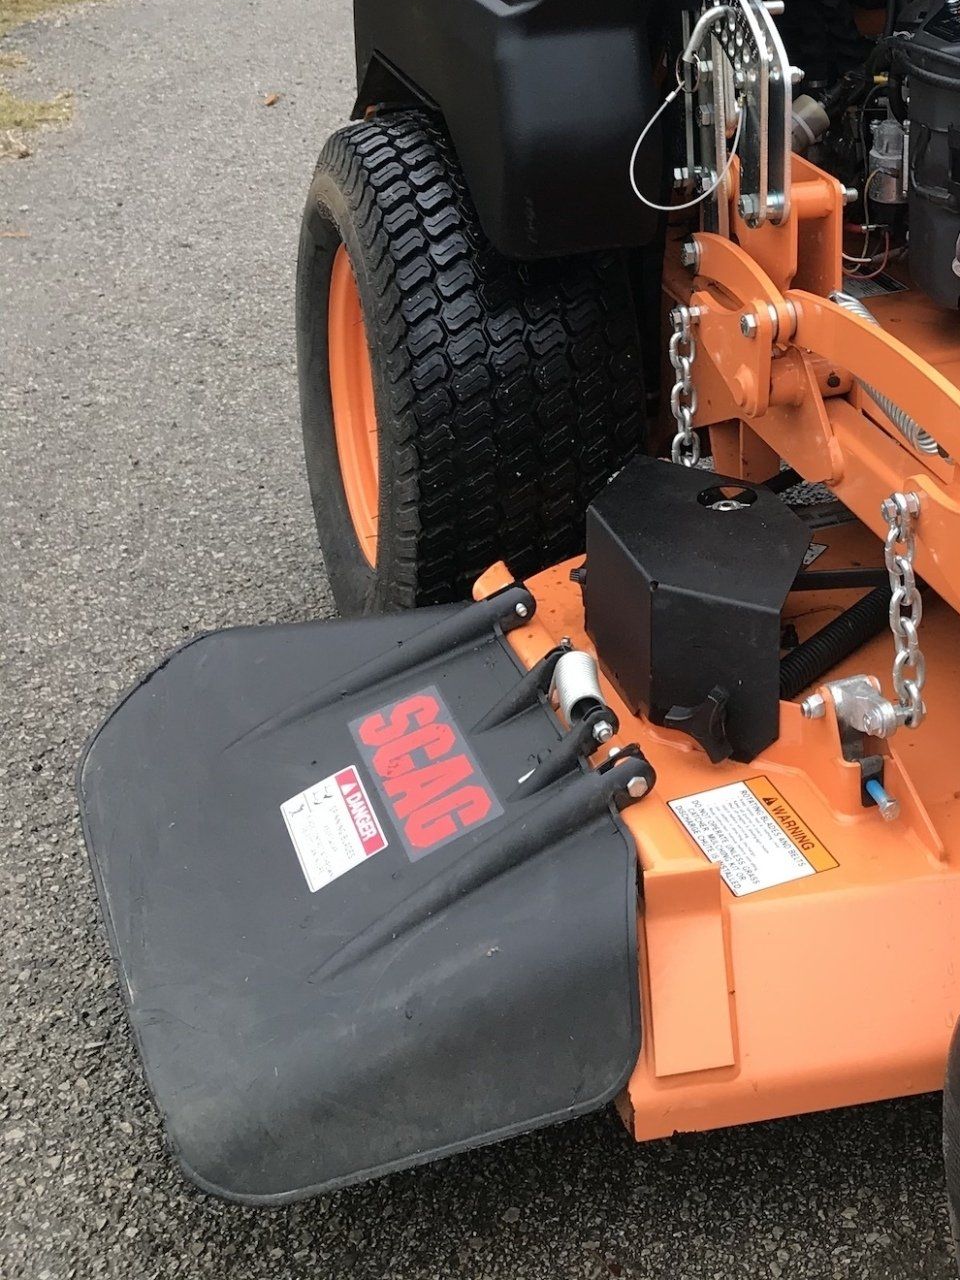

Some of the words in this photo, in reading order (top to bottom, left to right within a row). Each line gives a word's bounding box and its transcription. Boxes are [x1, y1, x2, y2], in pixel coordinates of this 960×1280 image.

[358, 694, 492, 848] SCAG
[345, 792, 377, 842] DANGER
[691, 799, 701, 807] DO
[707, 820, 728, 842] OPERATE
[725, 845, 745, 864] UNLESS
[742, 866, 759, 883] GRASS
[707, 833, 731, 861] MULCHING
[741, 790, 763, 814] ROTATING
[760, 815, 781, 836] BLADES
[778, 837, 791, 847] AND
[787, 848, 805, 866] BELTS
[772, 805, 814, 850] WARNING
